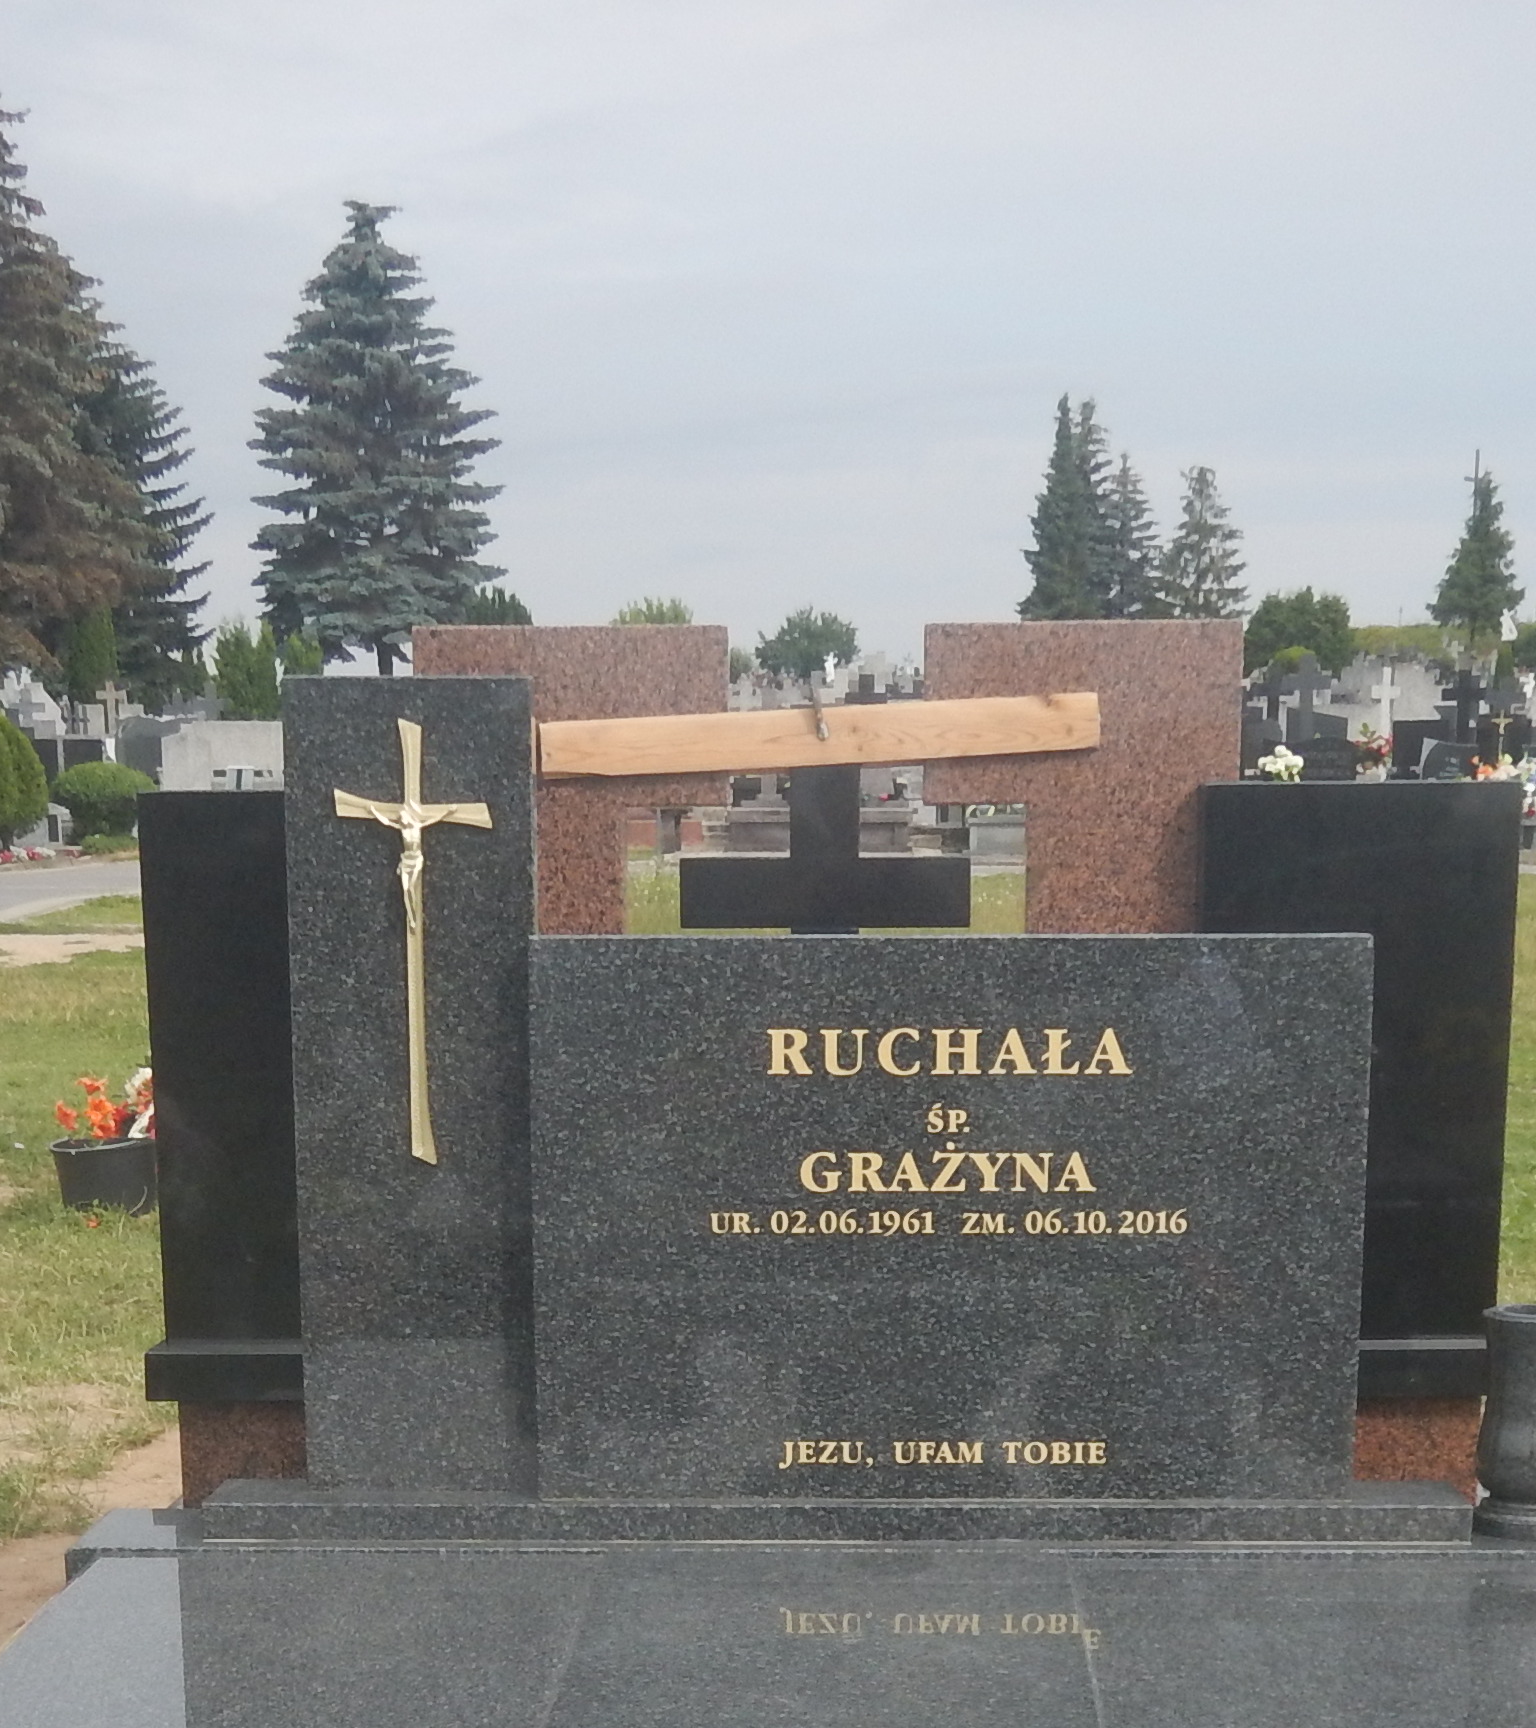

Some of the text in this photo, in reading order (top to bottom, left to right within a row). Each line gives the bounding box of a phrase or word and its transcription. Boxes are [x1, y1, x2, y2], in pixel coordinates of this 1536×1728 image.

[766, 1026, 1133, 1077] RUCHAŁA
[926, 1103, 970, 1134] ŚP.
[799, 1141, 1096, 1193] GRAŻYNA
[710, 1209, 1188, 1237] UR. 02.06.1961 ZM. 06.10.2016
[779, 1439, 1108, 1468] JEZU, UFAM TOBIE
